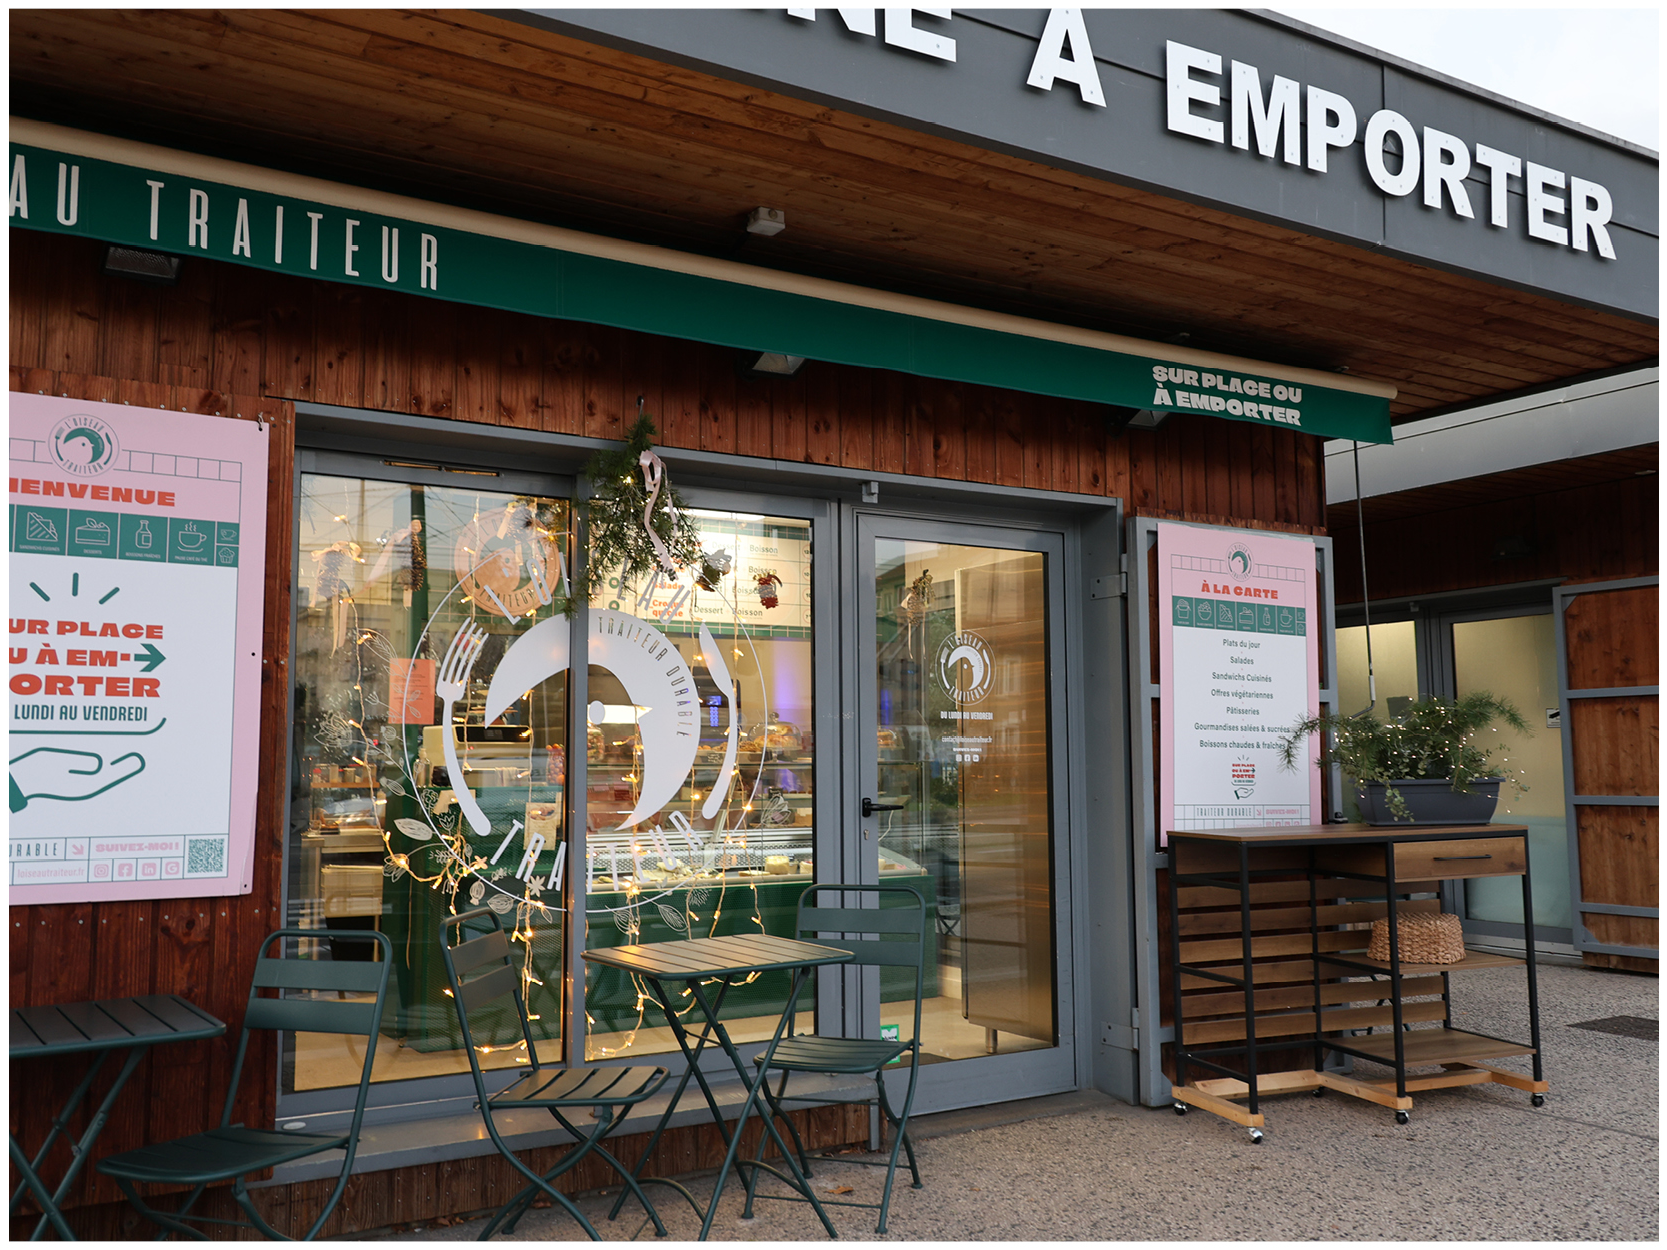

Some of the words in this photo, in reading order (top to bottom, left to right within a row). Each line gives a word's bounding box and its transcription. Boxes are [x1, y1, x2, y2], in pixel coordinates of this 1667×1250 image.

[1165, 39, 1618, 261] EMPORTER
[146, 179, 439, 291] TRAITEUR
[1152, 365, 1199, 387] SUR
[1202, 372, 1271, 398] PLACE
[1273, 385, 1302, 404] OU
[1153, 382, 1173, 406] À
[1175, 389, 1302, 426] EMPORTER
[64, 417, 104, 432] L'OISEAU
[62, 459, 104, 474] TRAITEUR
[712, 541, 741, 551] Desset
[750, 545, 778, 553] Boisson
[1201, 580, 1210, 593] À
[1213, 584, 1231, 595] LA
[1233, 586, 1279, 600] CARTE
[694, 606, 723, 614] Dessert
[56, 620, 163, 640] PLACE
[947, 633, 983, 650] L'OISEAU
[1222, 638, 1238, 647] Plats
[1239, 639, 1247, 648] du
[1248, 641, 1261, 650] jour
[35, 643, 59, 665] À
[66, 650, 131, 667] EM-
[1230, 655, 1254, 665] Salades
[598, 616, 668, 662] TRAITEUR
[665, 665, 692, 737] DURABLE
[1212, 671, 1245, 682] Sandwichs
[1246, 673, 1272, 683] Cuisinés
[9, 673, 161, 698] ORTER
[949, 686, 985, 702] TRAITEUR
[1211, 688, 1230, 698] Offres
[1231, 690, 1274, 700] végétariennes
[14, 704, 55, 720] LUNDI
[59, 704, 78, 721] AU
[83, 705, 148, 722] VENDREDI
[971, 712, 993, 720] VENDREDI
[1226, 706, 1260, 715] Pâtisseries
[1194, 722, 1239, 732] Gourmandises
[1240, 724, 1260, 732] salées
[1267, 725, 1291, 733] sucrées
[1199, 739, 1228, 748] Boissons
[1229, 740, 1255, 749] chaudes
[1256, 741, 1261, 749] &
[1262, 741, 1286, 750] fraîches
[1196, 807, 1224, 816] TRAITEUR
[1227, 807, 1252, 817] DURABLE
[490, 810, 705, 893] TRAITEUR
[17, 868, 85, 879] loiseautraiteur.fr
